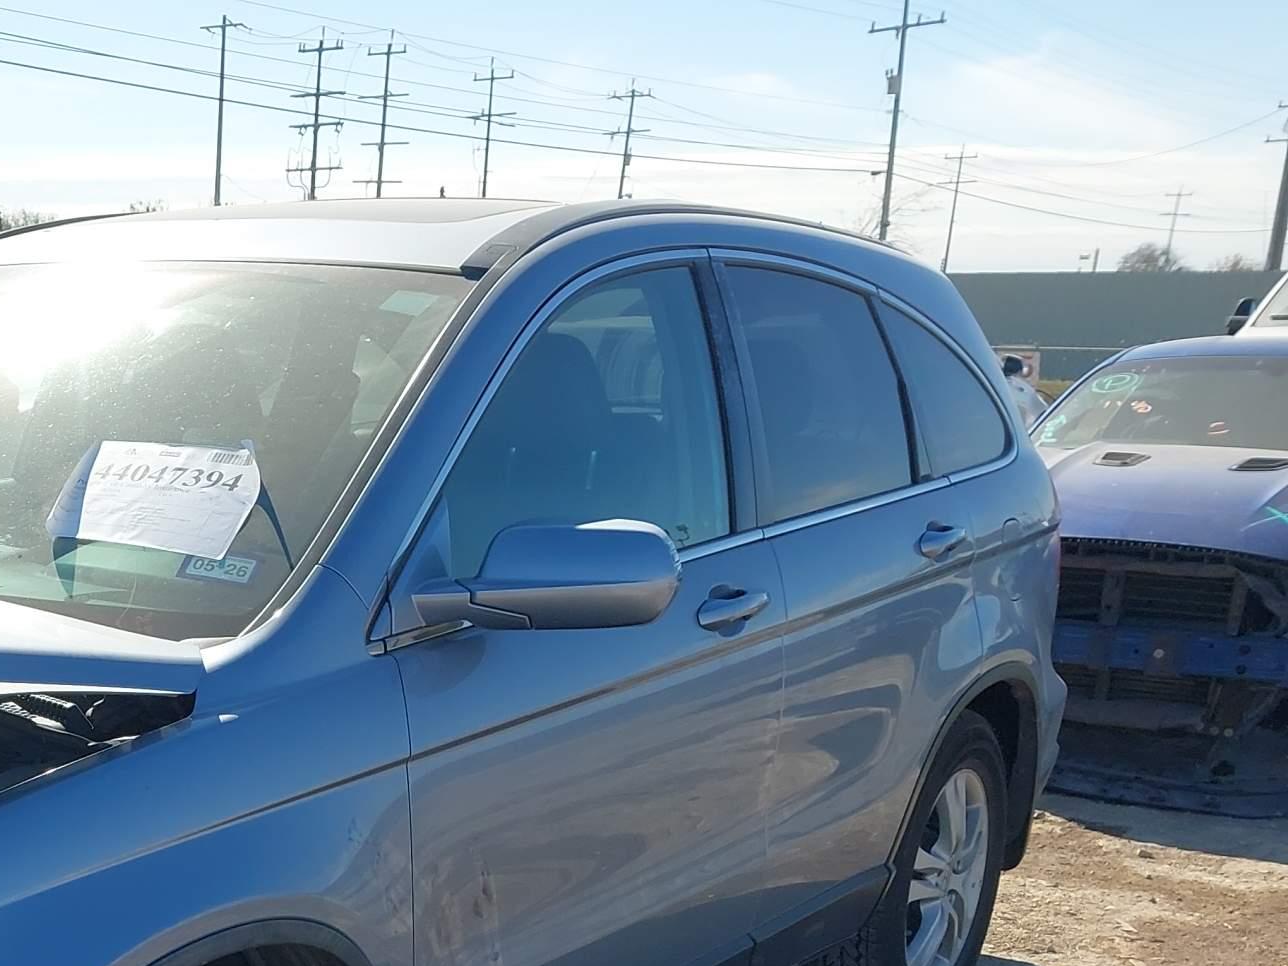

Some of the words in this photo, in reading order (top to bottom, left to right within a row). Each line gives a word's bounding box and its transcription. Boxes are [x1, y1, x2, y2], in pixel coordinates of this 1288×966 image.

[94, 463, 244, 492] 44047394
[193, 558, 216, 572] 05
[224, 563, 249, 578] 26
